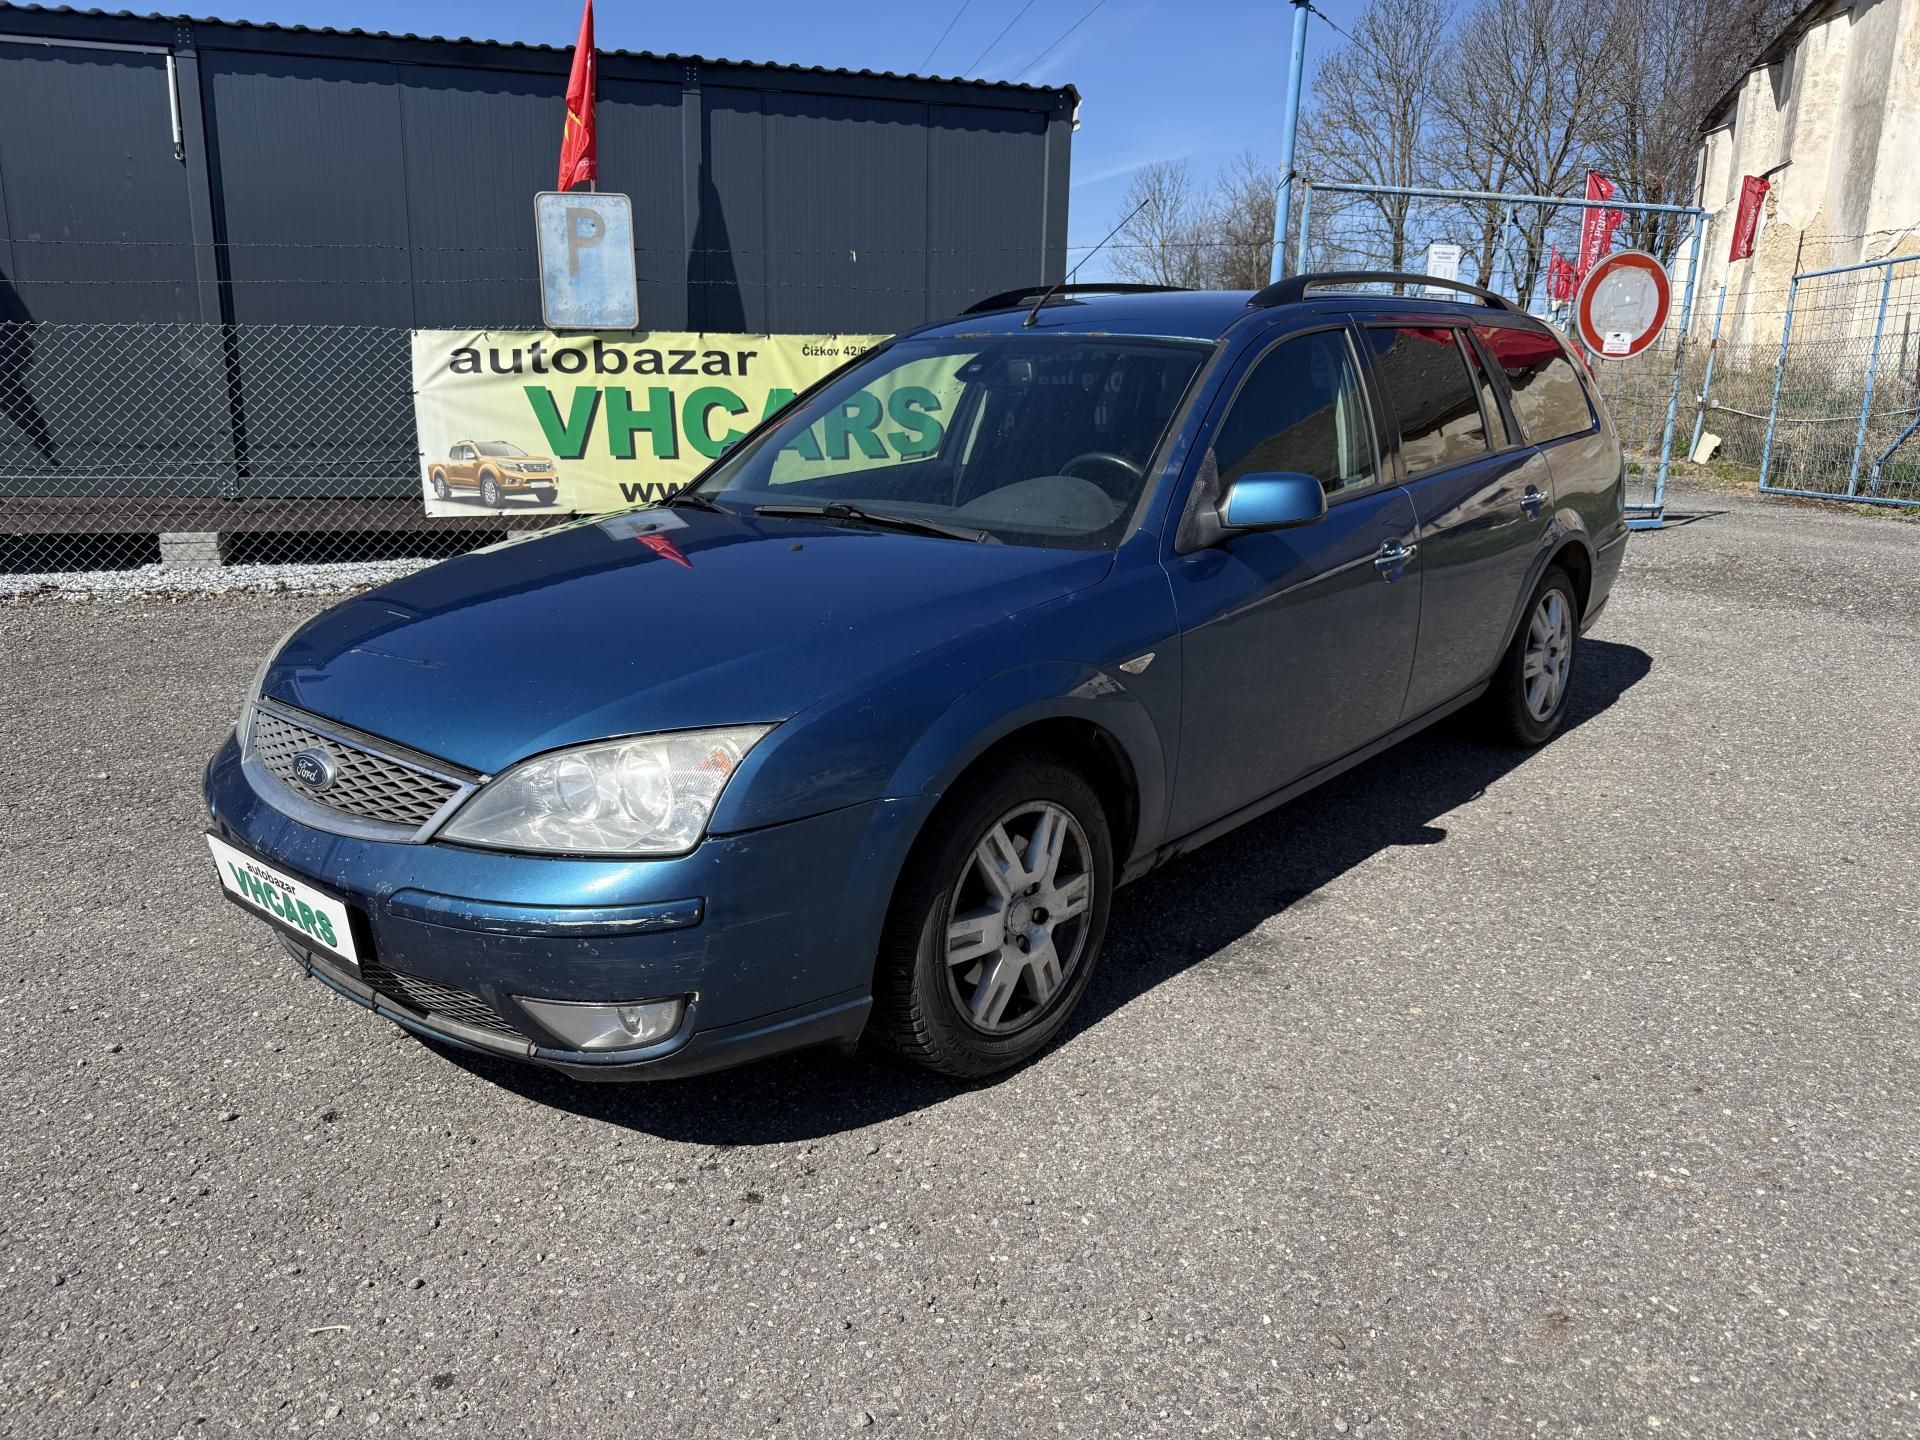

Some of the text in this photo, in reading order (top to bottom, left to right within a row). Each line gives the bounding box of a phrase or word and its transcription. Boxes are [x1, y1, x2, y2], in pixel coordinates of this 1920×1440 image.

[566, 207, 606, 278] P
[449, 339, 759, 376] autobazar
[802, 343, 840, 357] Čížkov
[523, 385, 945, 461] VHCARS
[296, 758, 319, 782] Ford
[245, 861, 297, 896] autobazar
[227, 860, 338, 948] VHCARS
